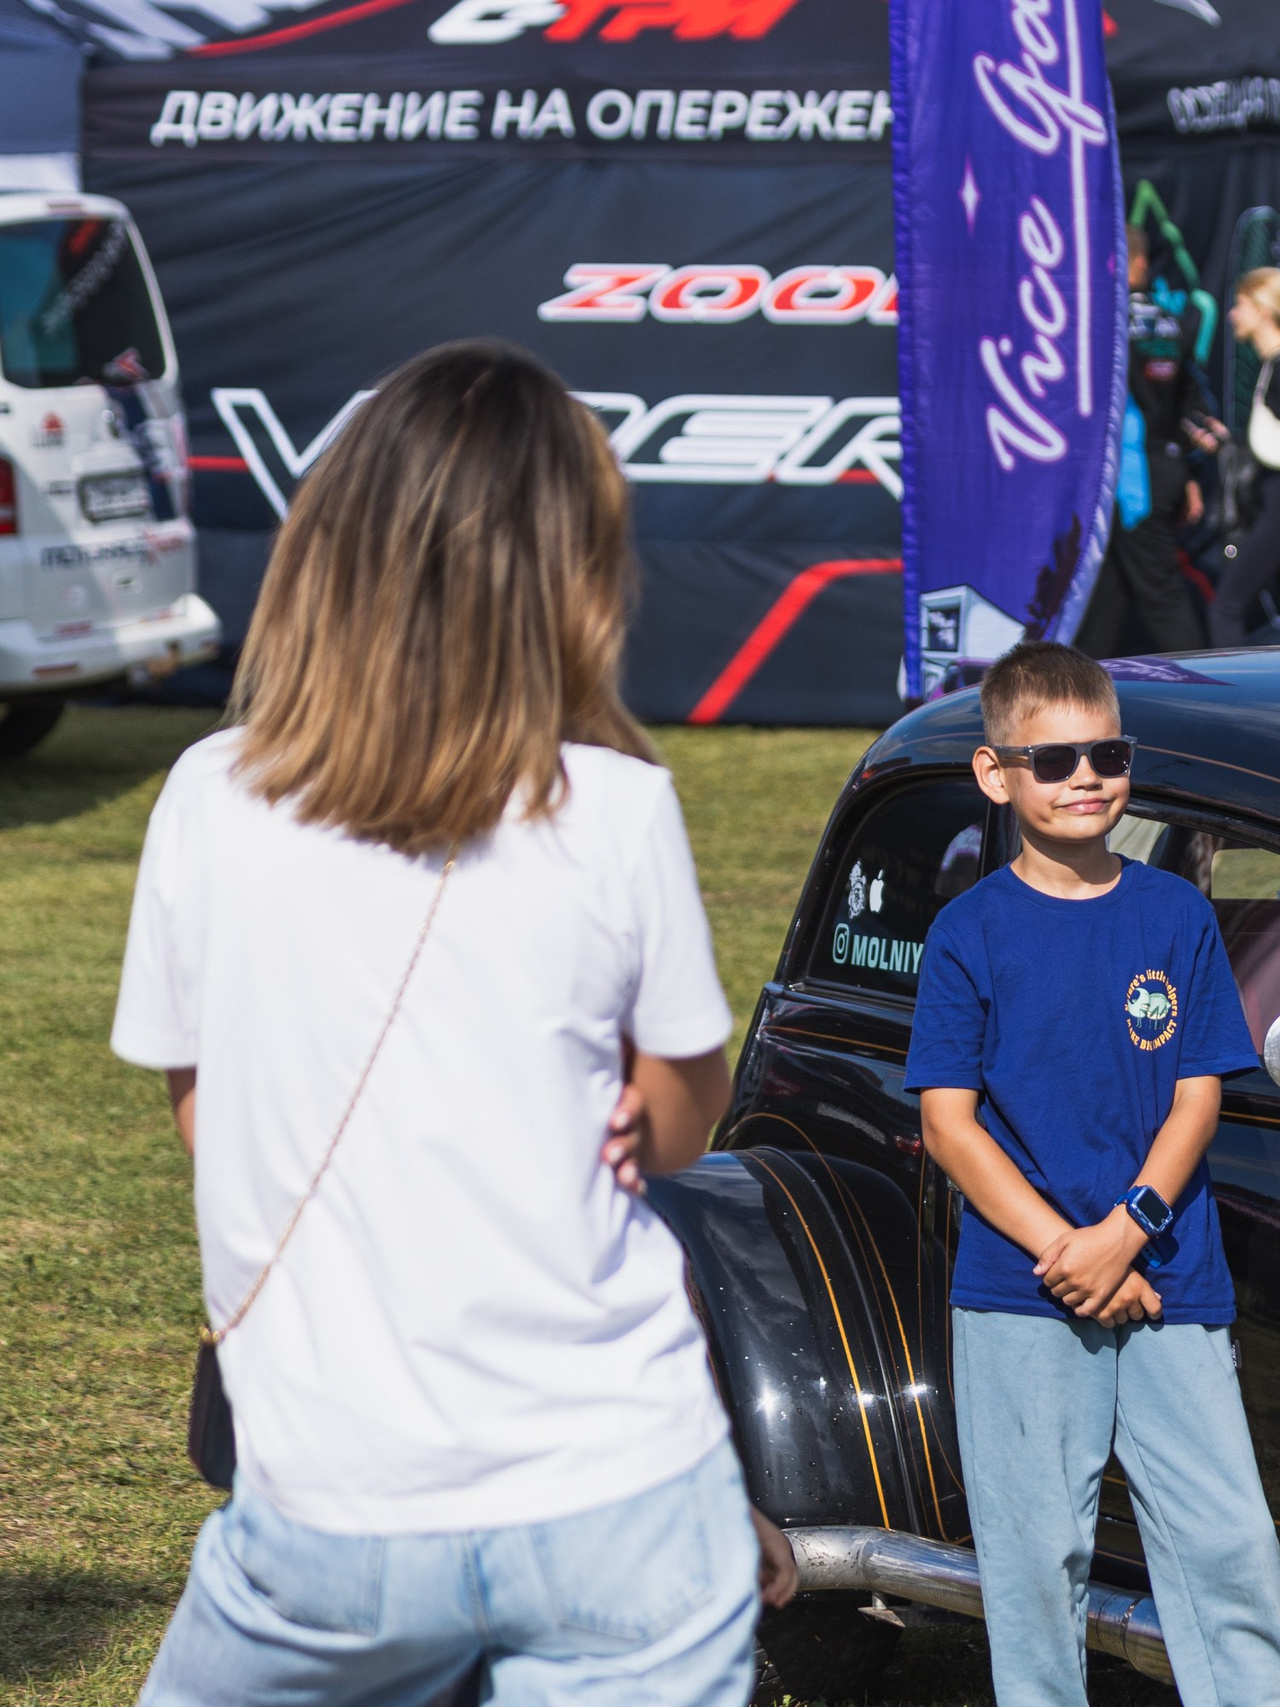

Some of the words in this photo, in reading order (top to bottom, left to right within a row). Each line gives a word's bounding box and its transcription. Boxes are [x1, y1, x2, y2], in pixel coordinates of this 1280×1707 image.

[150, 89, 485, 148] ДВИЖЕНИЕ
[491, 87, 576, 141] НА
[979, 194, 1069, 471] Vice
